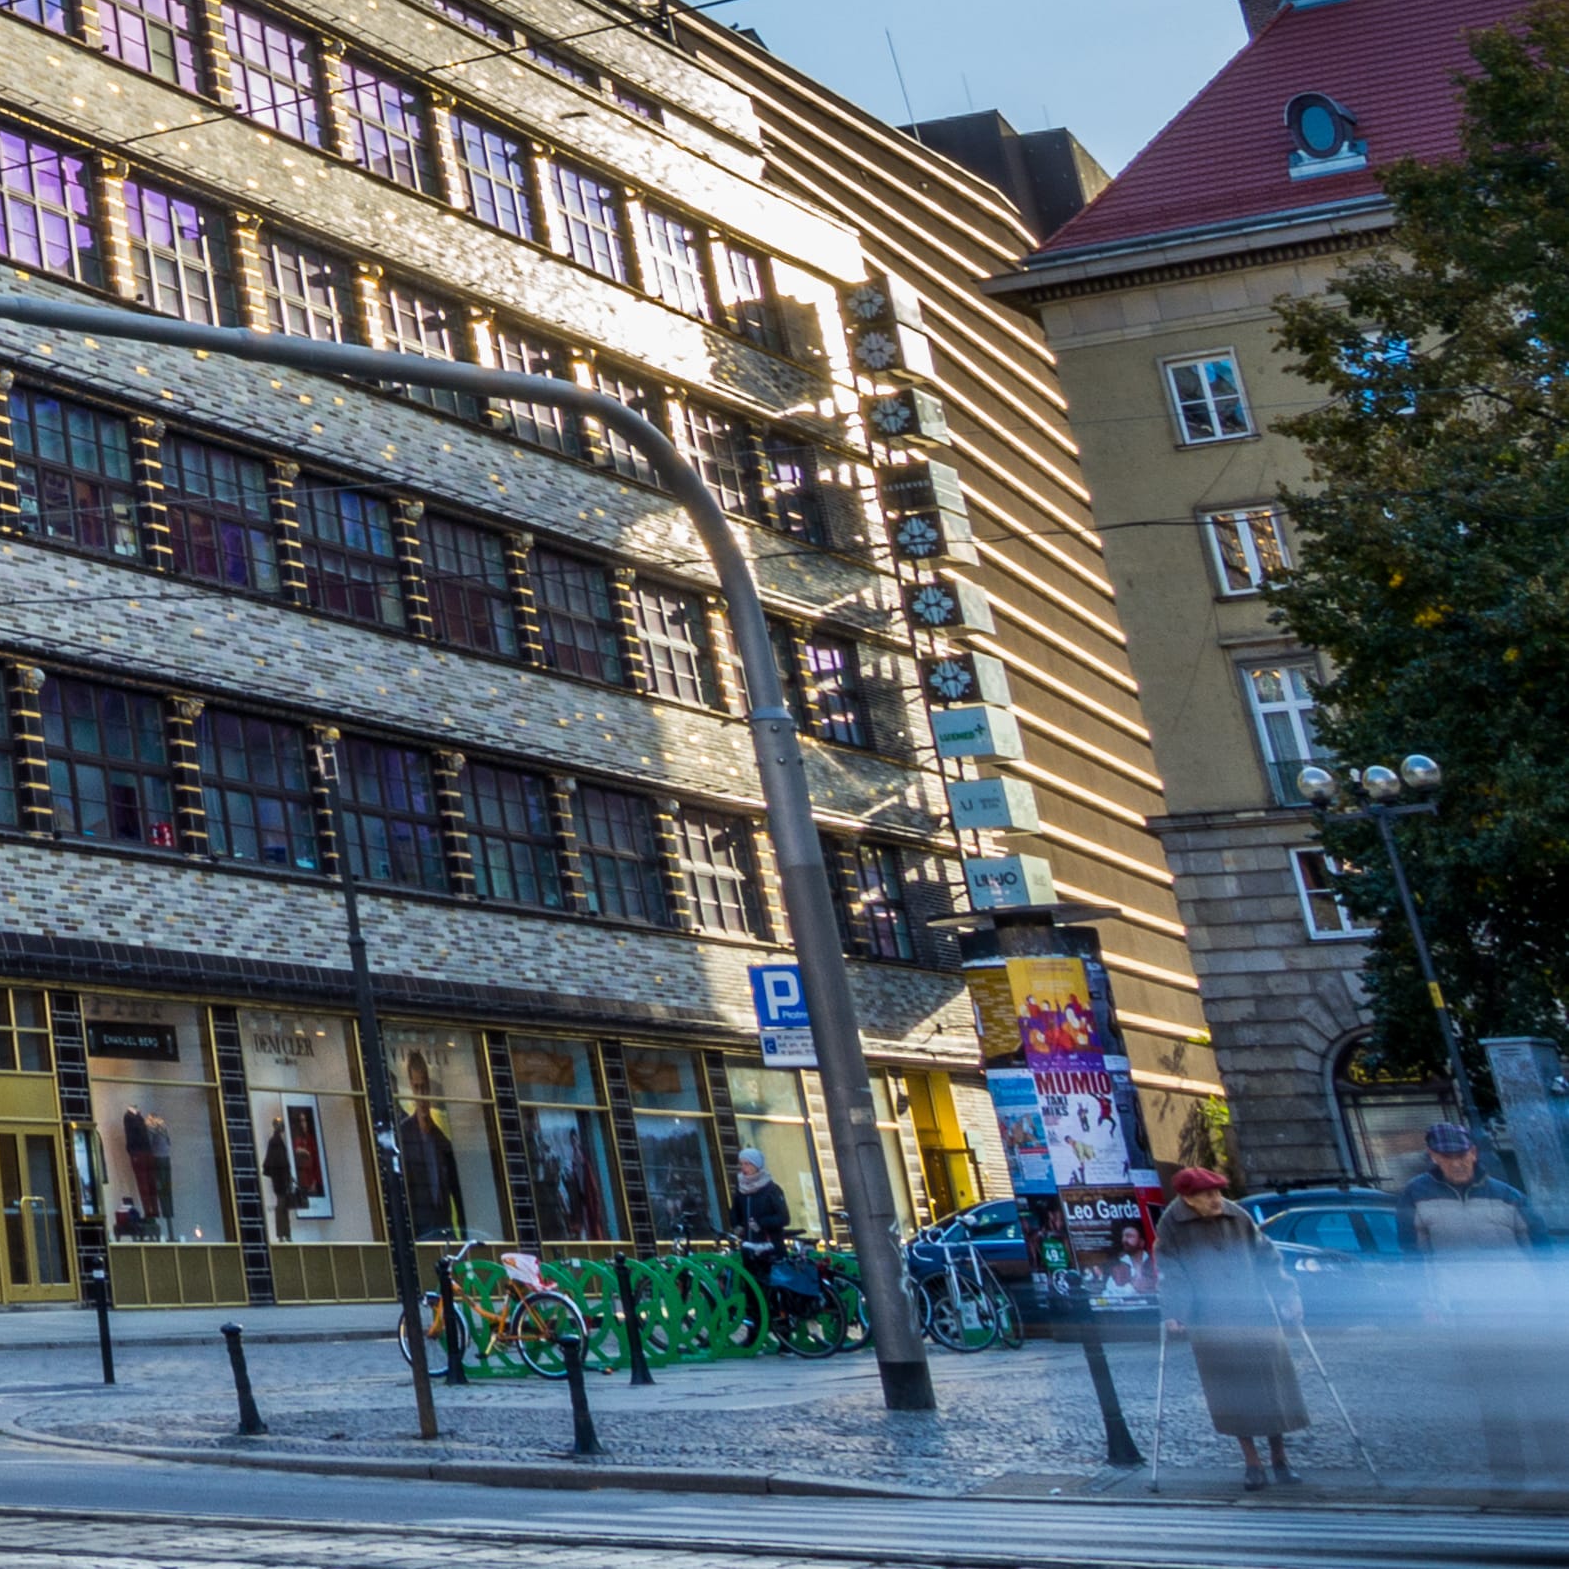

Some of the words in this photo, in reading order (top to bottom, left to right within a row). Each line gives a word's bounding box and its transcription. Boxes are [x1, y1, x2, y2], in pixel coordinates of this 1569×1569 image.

[762, 971, 801, 1021] P
[1034, 1071, 1112, 1096] MUMIO
[1041, 1106, 1070, 1117] MIKS
[1062, 1200, 1094, 1221] Leo
[1096, 1198, 1142, 1221] Garda
